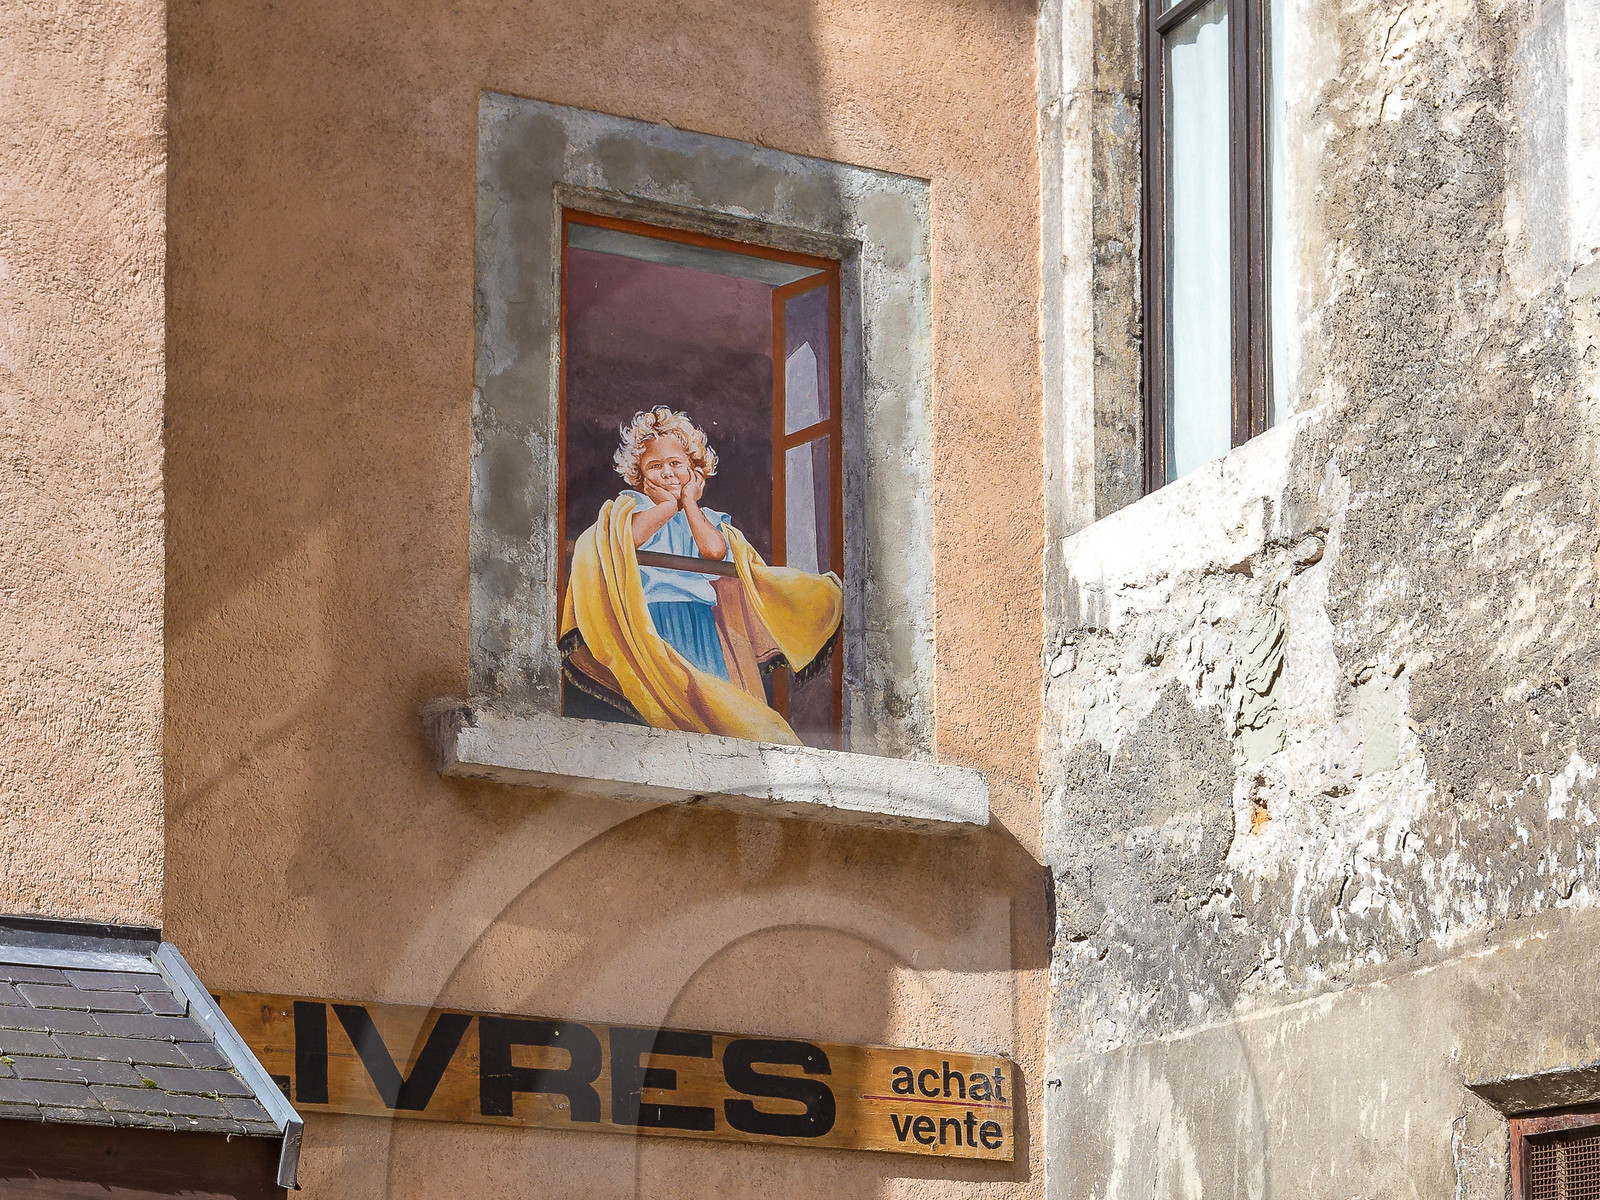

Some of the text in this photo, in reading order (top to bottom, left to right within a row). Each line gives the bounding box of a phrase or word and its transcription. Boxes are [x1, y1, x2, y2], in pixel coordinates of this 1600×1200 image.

[212, 995, 836, 1138] IVRES
[891, 1061, 1007, 1103] achat
[890, 1111, 1003, 1150] vente
